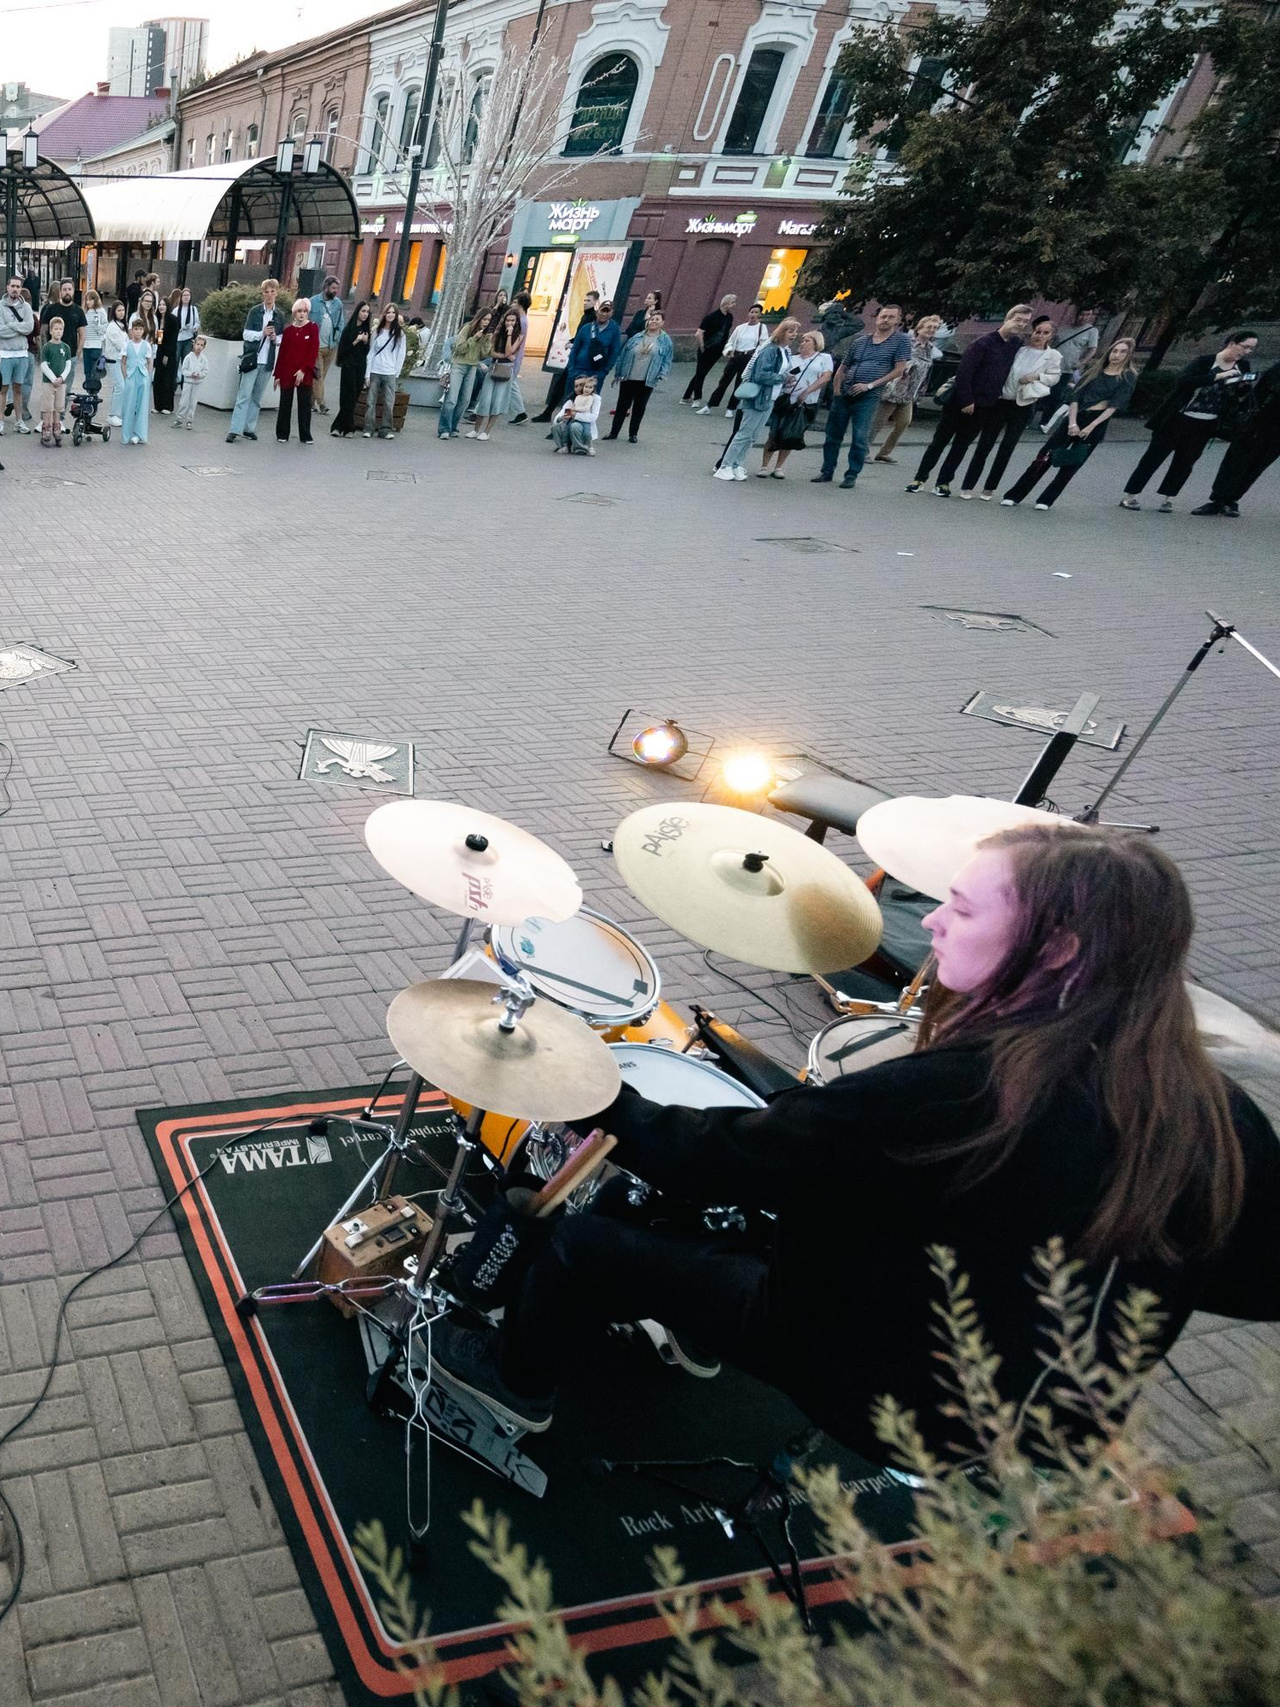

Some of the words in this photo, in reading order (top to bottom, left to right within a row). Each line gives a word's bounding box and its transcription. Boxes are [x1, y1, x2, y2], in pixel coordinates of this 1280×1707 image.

[548, 203, 600, 219] Жизнь
[548, 218, 594, 234] март
[685, 218, 756, 238] Жизньмарт
[219, 1145, 308, 1174] TAMA
[620, 1510, 674, 1536] Rock
